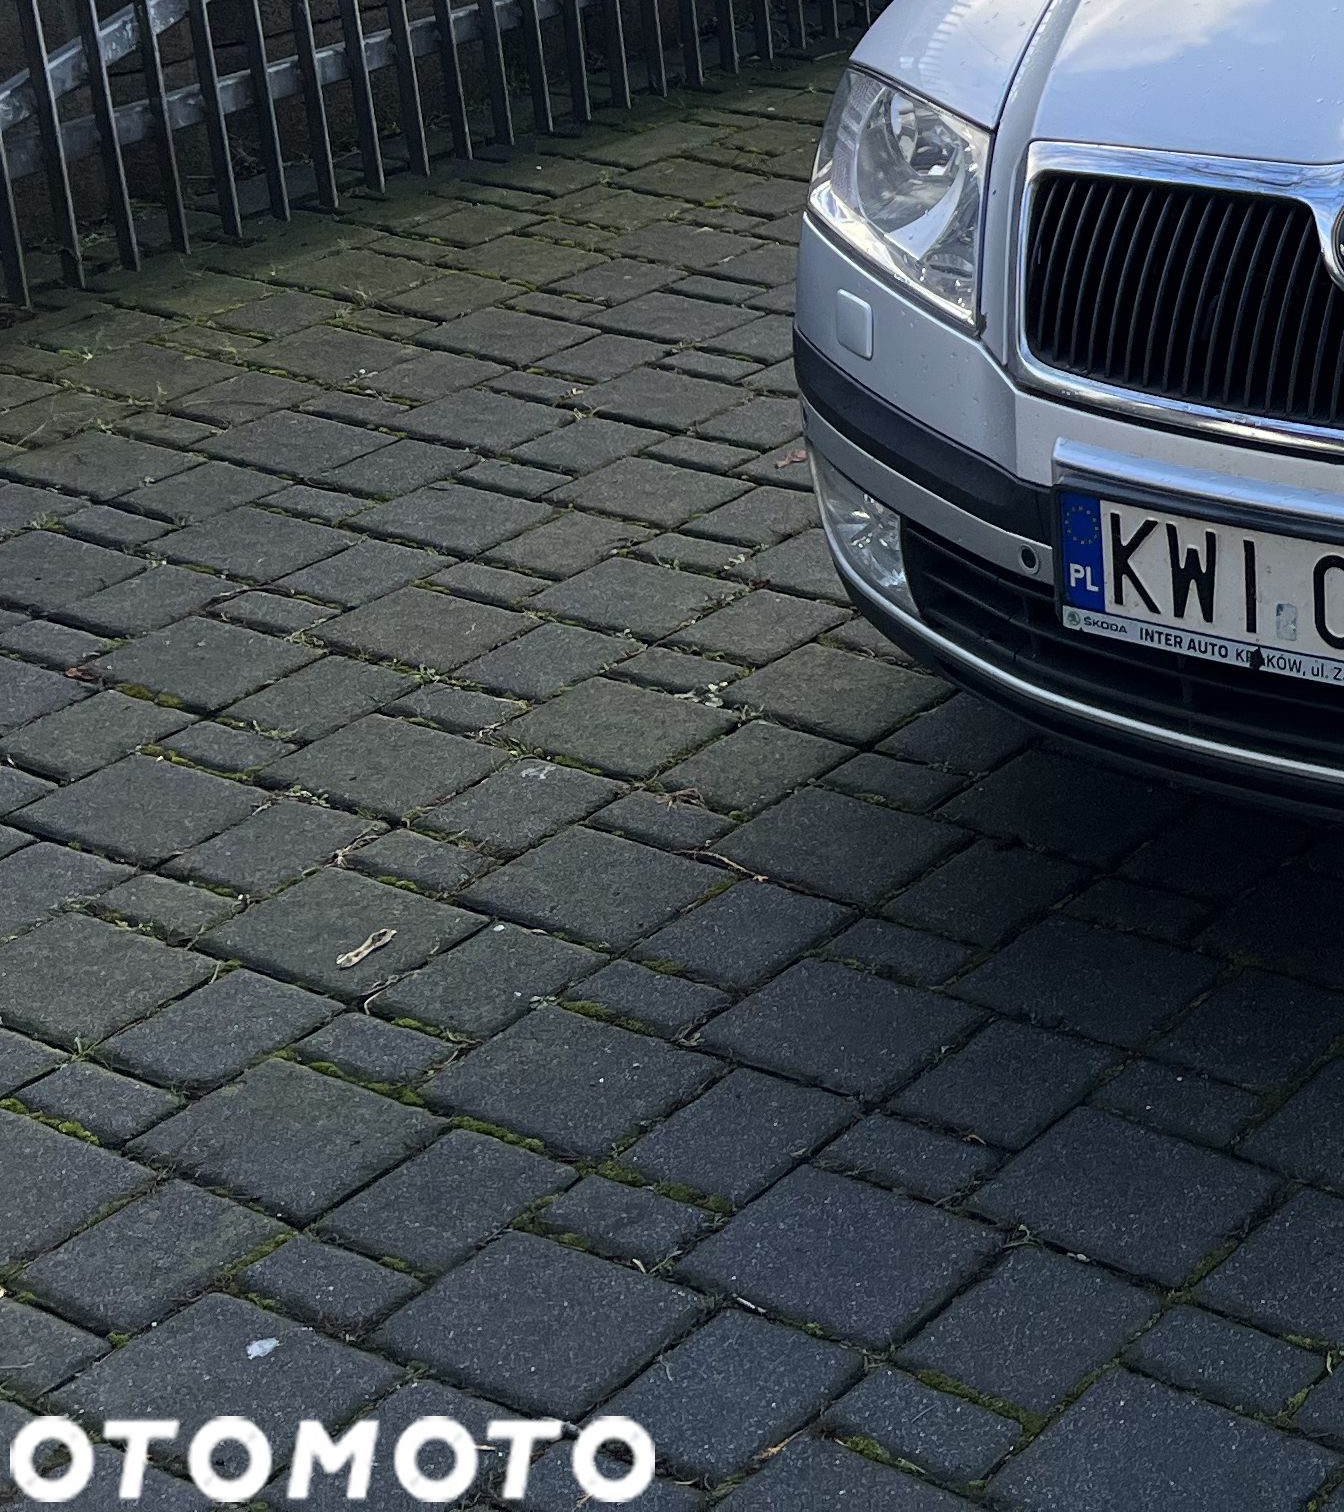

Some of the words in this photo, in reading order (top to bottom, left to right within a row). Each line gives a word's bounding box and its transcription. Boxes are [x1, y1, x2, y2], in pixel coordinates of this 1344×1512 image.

[1069, 562, 1099, 592] PL
[1109, 512, 1257, 633] KWI
[1139, 627, 1183, 649] INTER
[1187, 638, 1229, 658] AUTO
[1311, 665, 1329, 679] ul.
